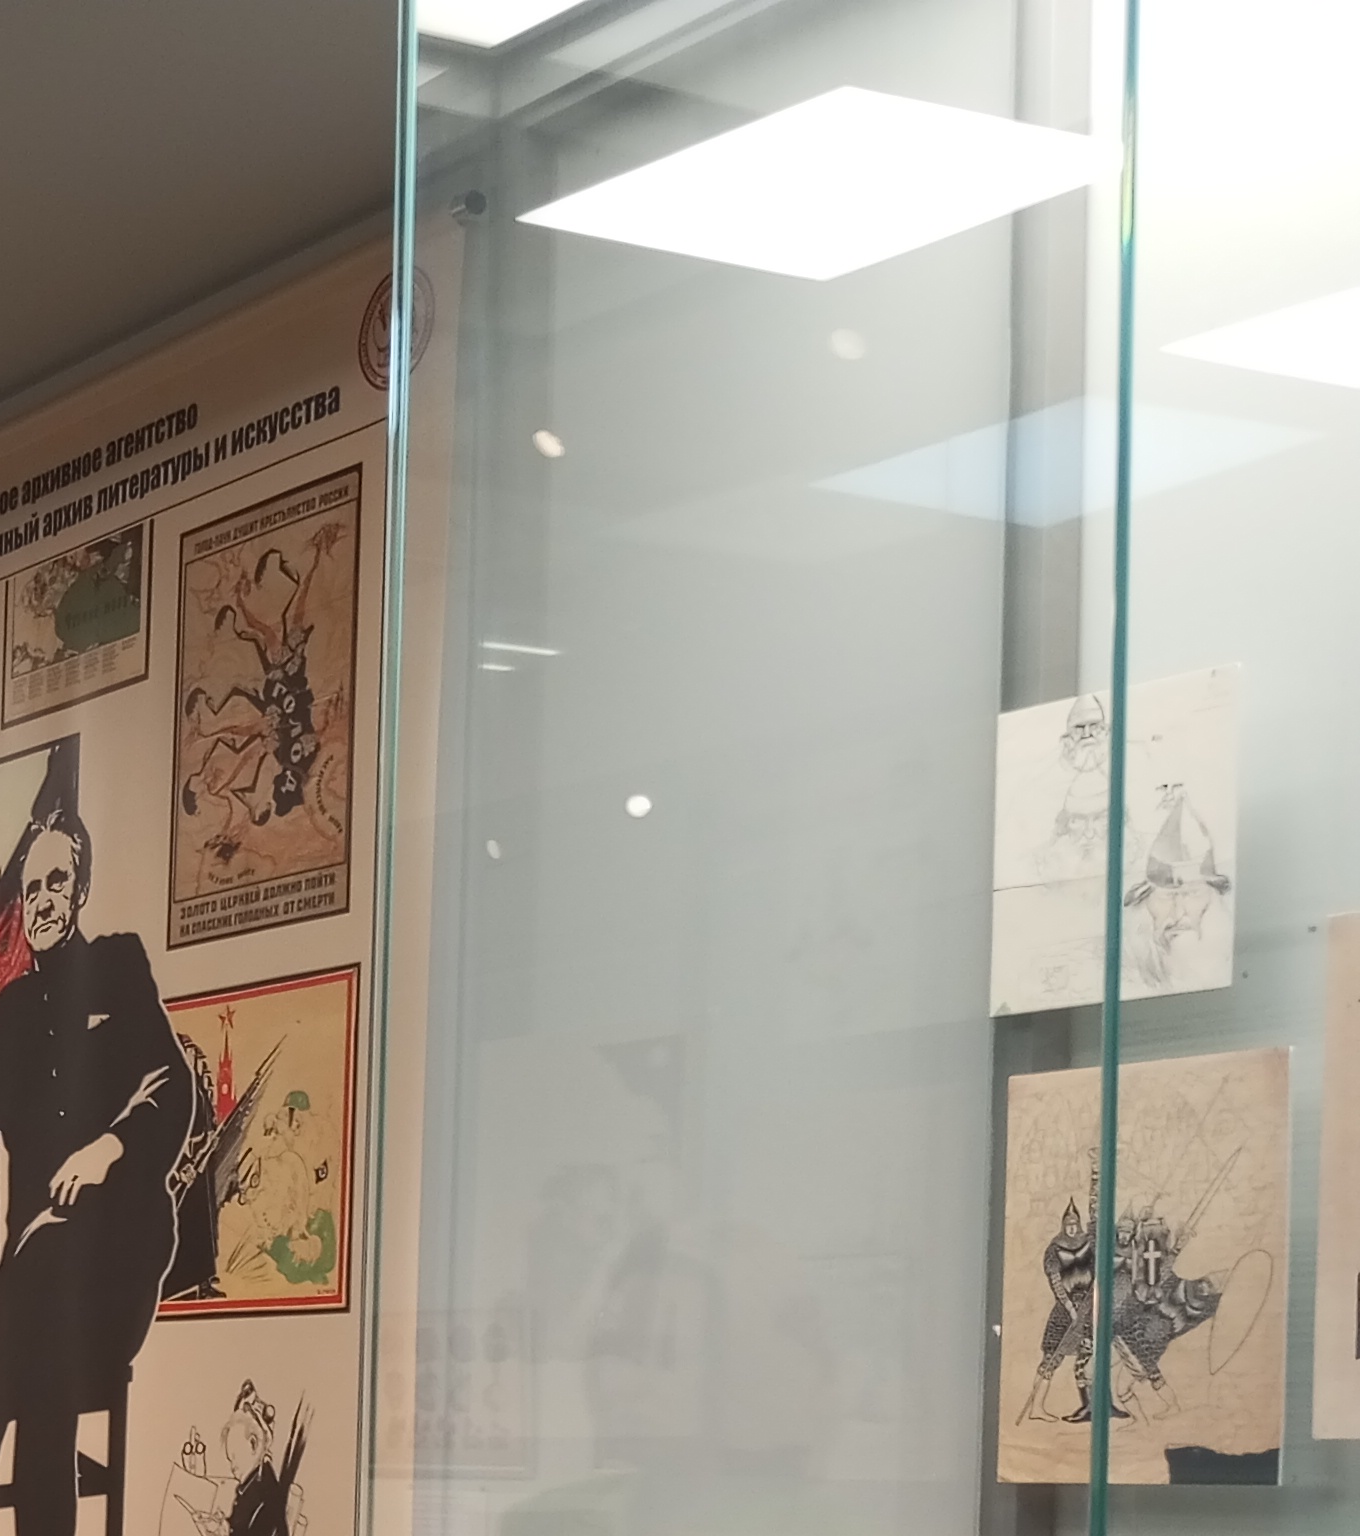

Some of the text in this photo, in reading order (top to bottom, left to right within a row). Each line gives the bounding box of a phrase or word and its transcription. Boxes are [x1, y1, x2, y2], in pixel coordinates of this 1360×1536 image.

[21, 450, 102, 506] архивное
[106, 403, 198, 471] агентство
[43, 493, 93, 537] архив
[96, 441, 209, 515] литературы
[214, 434, 228, 463] и
[231, 386, 340, 456] искусства
